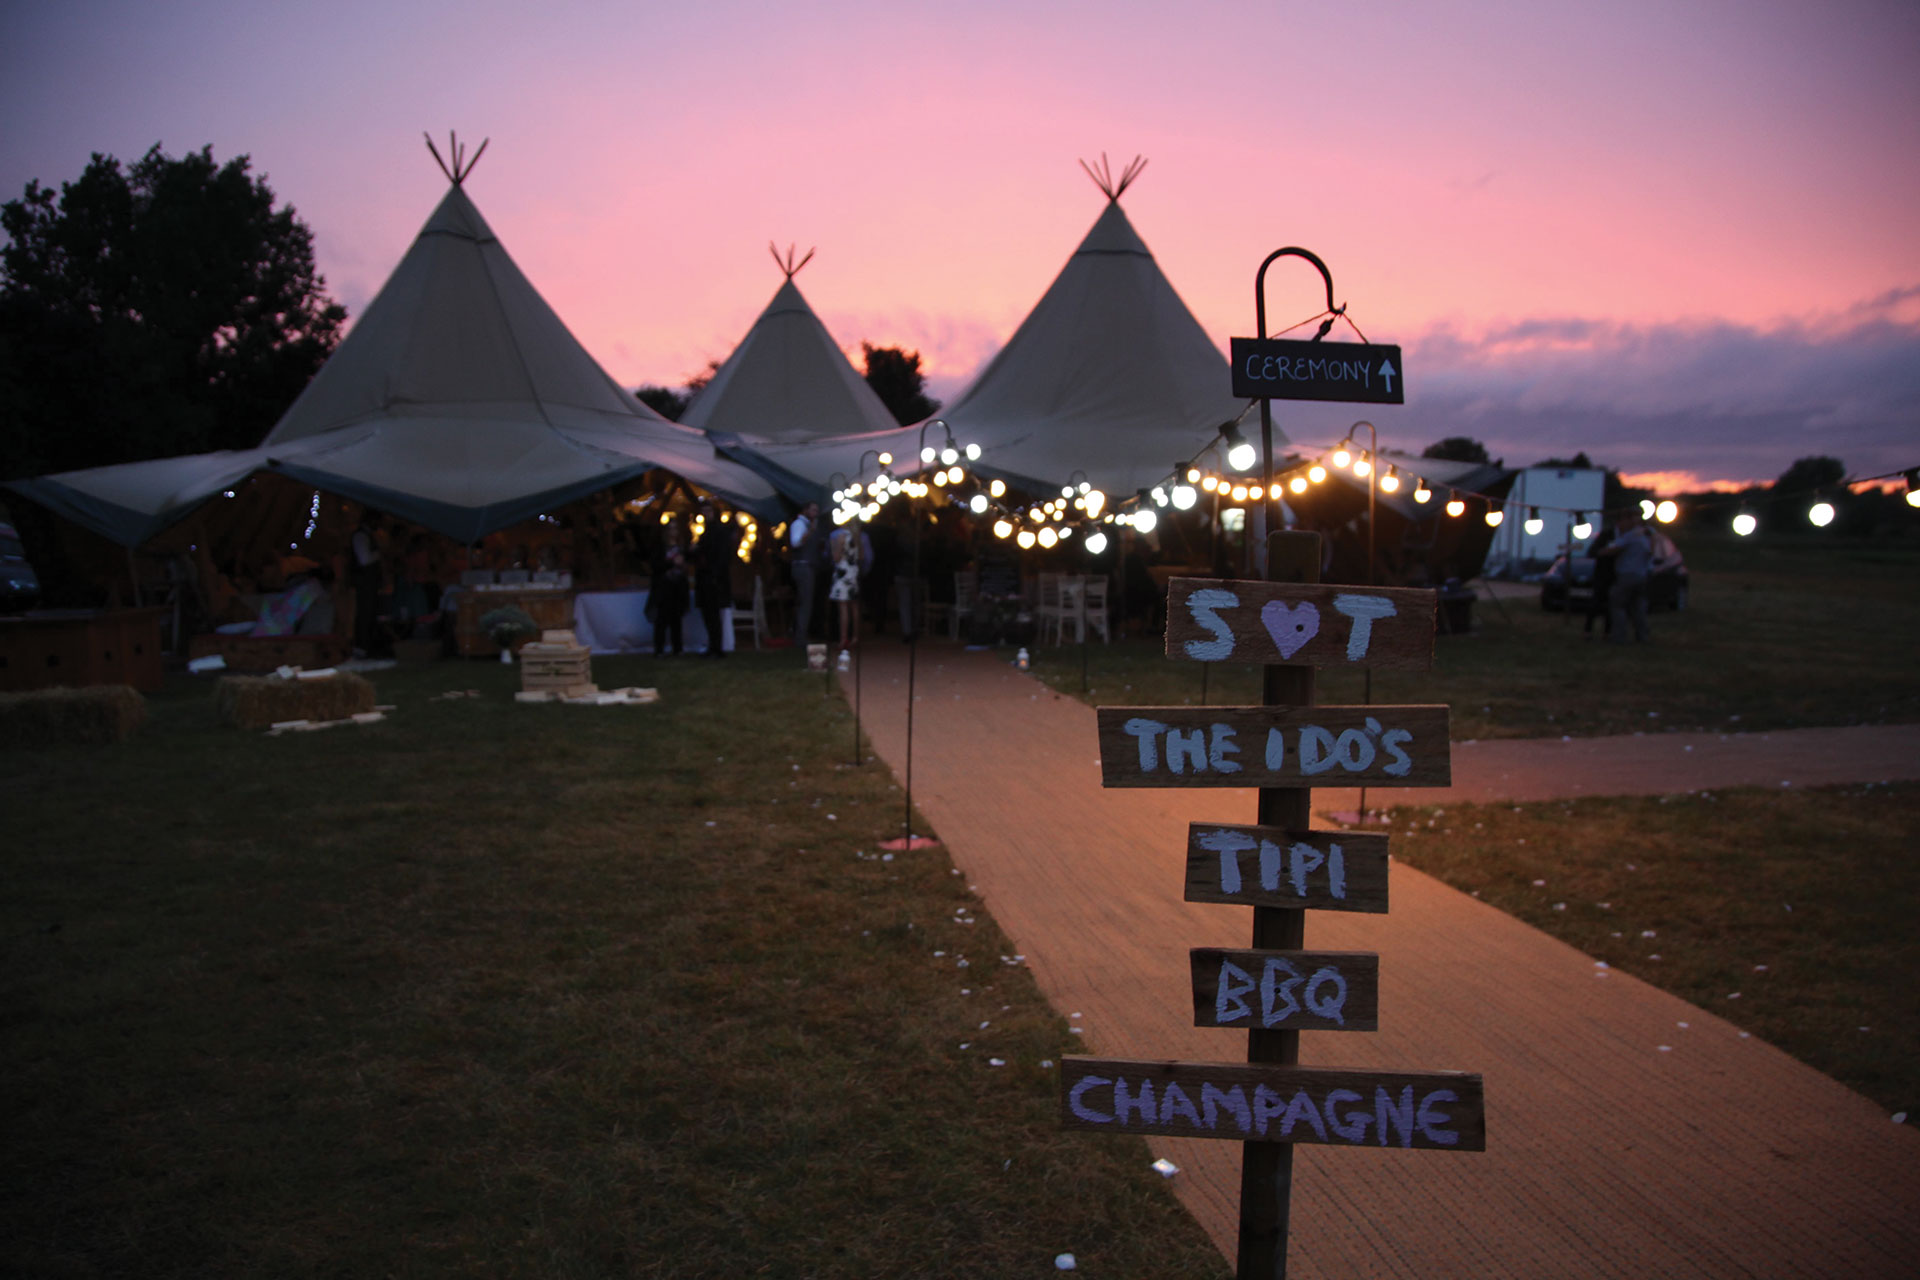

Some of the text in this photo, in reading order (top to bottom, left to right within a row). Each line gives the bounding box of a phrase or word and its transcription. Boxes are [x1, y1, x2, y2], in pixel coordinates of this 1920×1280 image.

[1244, 353, 1371, 388] CEREMONY
[1184, 588, 1398, 662] S T
[1123, 716, 1414, 777] THE I DO'S
[1196, 829, 1346, 898] TIPI
[1215, 957, 1348, 1028] BBQ
[1068, 1075, 1461, 1149] CHAMPAGNE
